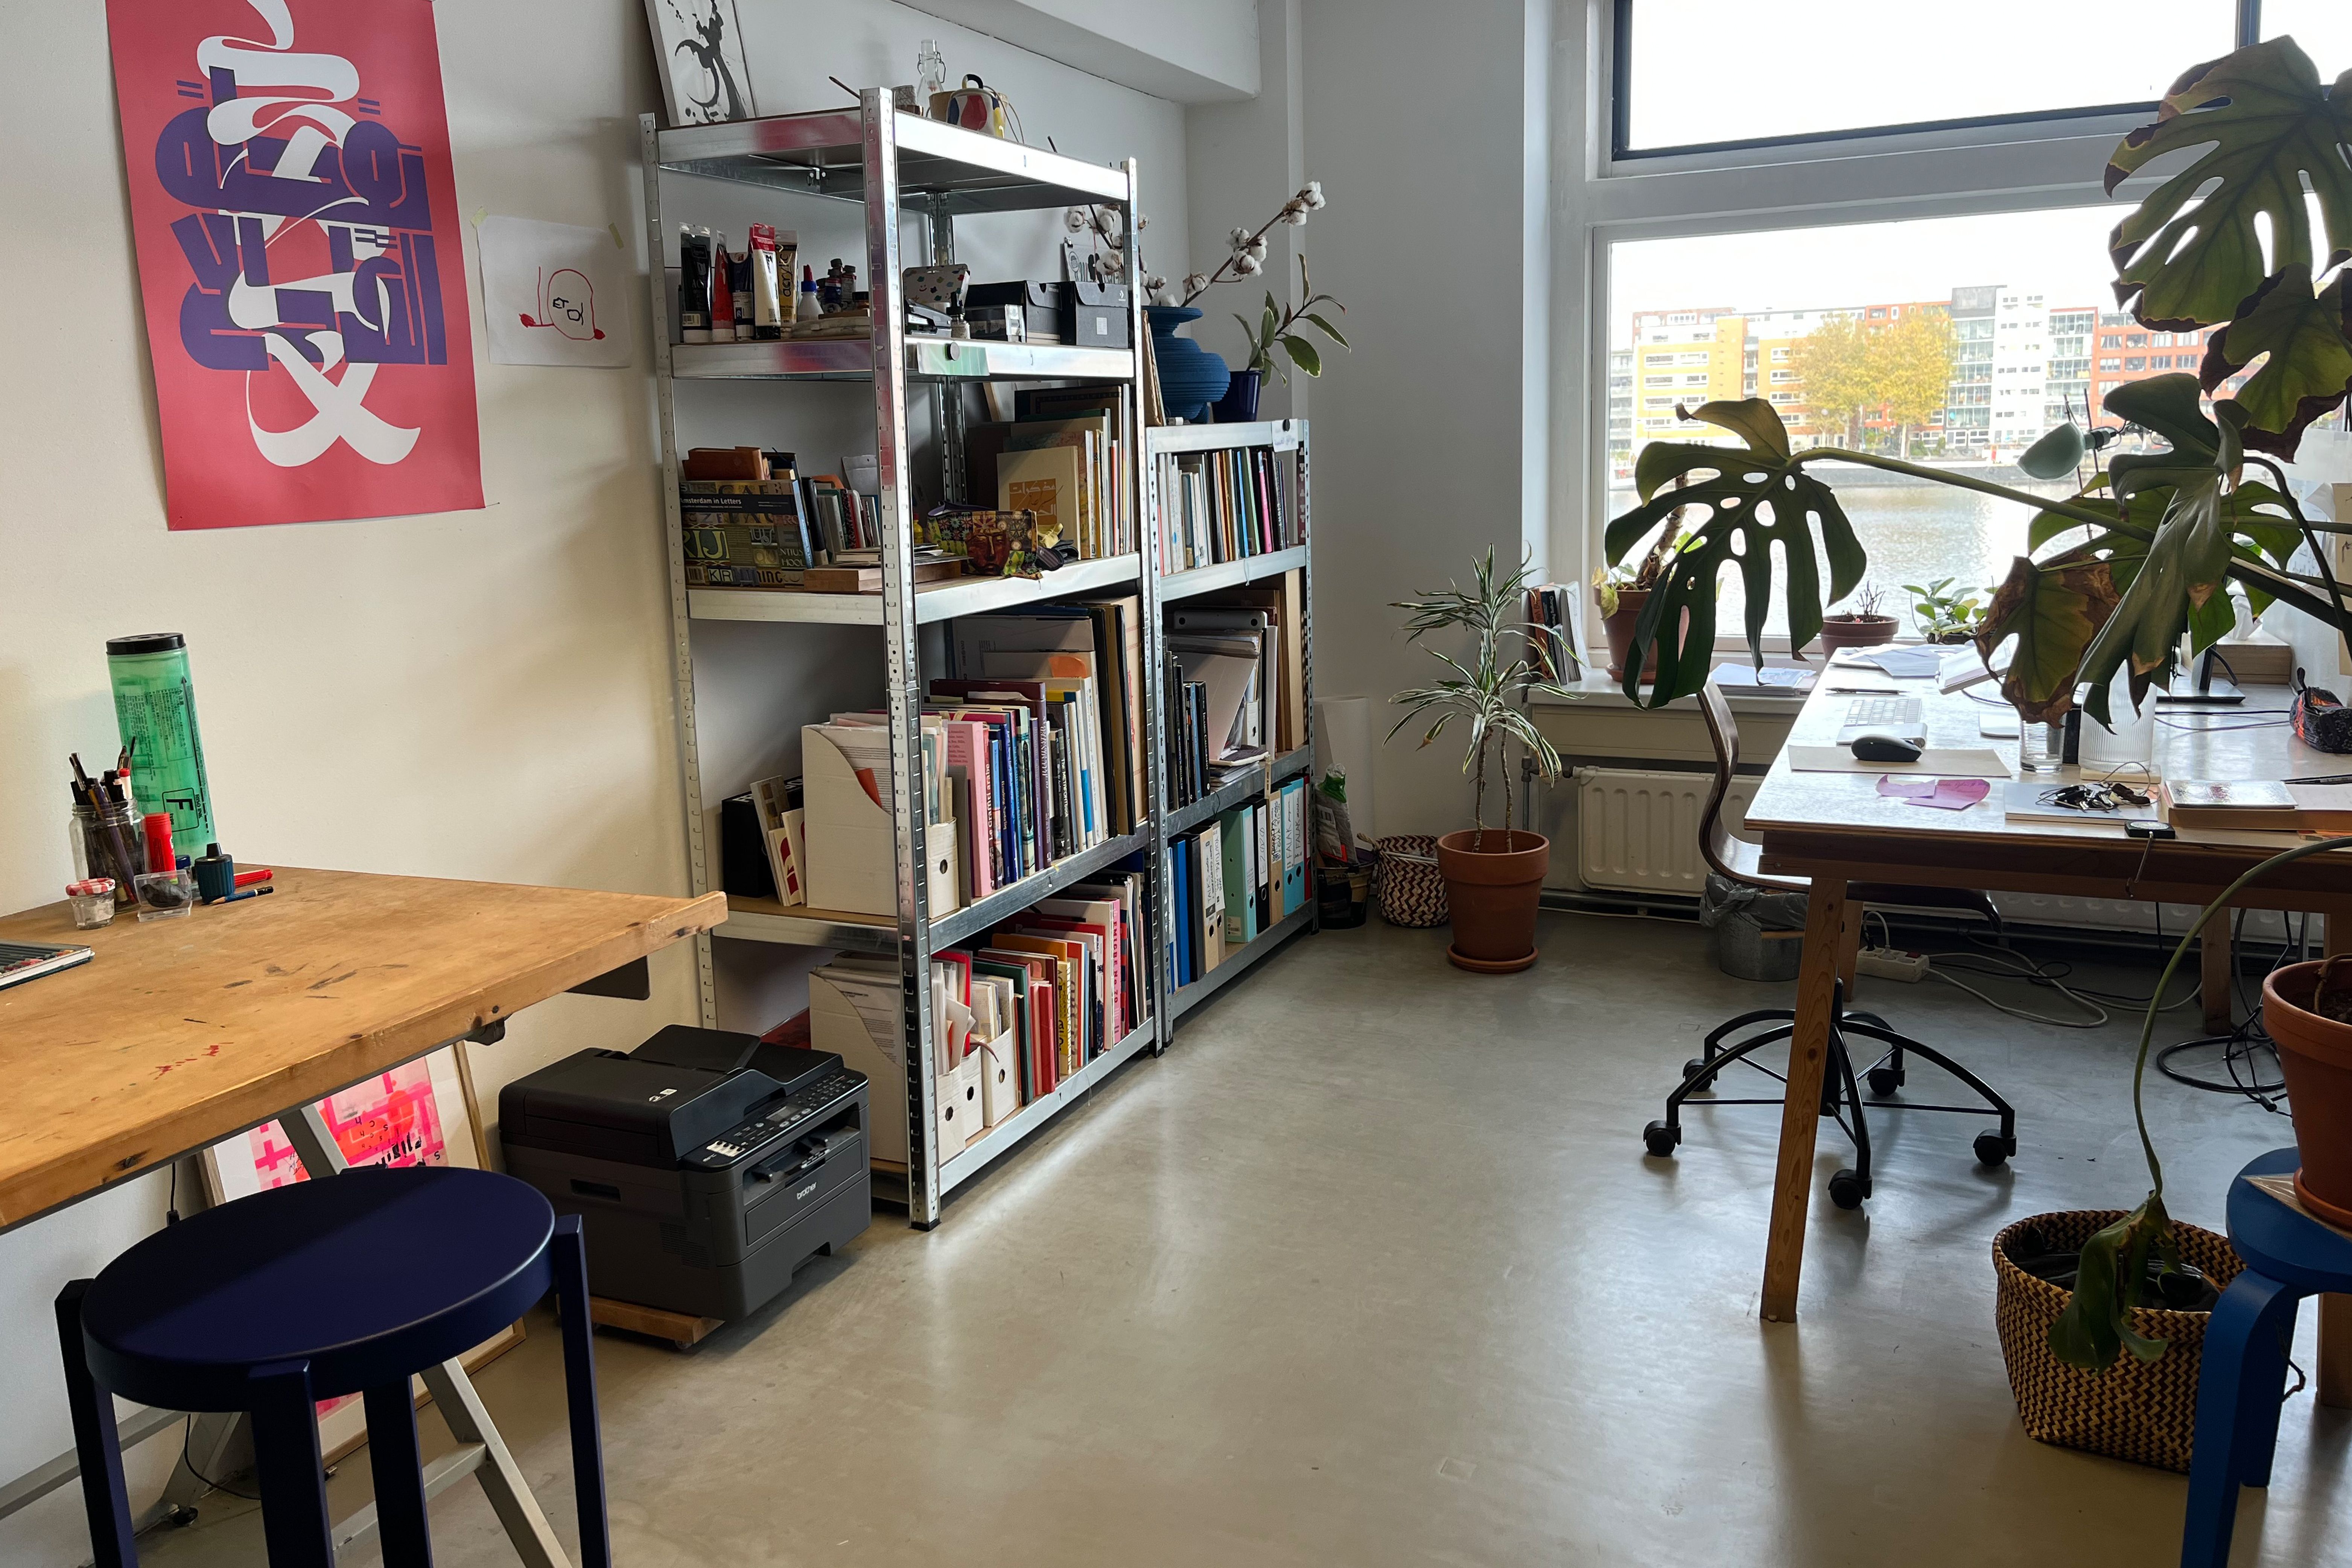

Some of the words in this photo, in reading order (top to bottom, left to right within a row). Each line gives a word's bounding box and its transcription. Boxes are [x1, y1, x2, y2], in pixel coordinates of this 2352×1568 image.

[778, 253, 793, 297] acrylic
[166, 798, 194, 811] F
[988, 830, 993, 841] Le
[797, 1182, 816, 1200] brother
